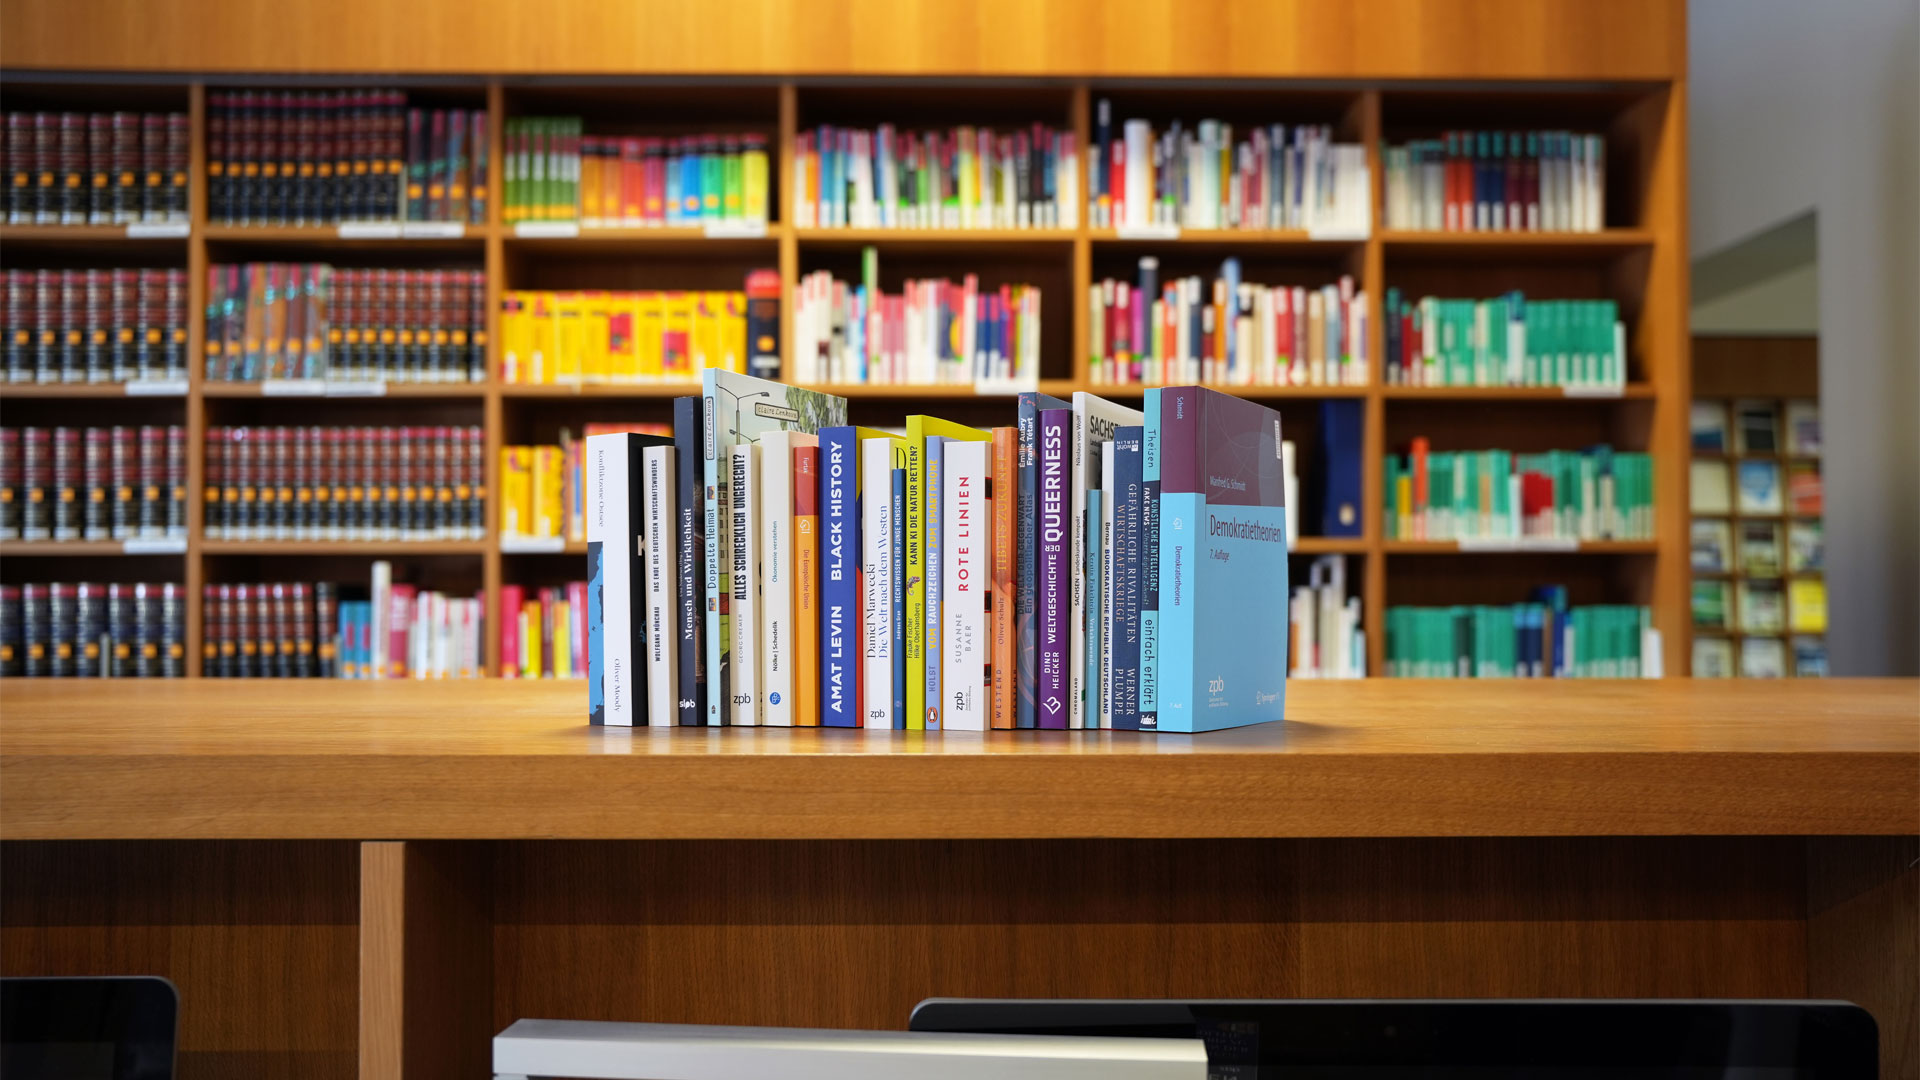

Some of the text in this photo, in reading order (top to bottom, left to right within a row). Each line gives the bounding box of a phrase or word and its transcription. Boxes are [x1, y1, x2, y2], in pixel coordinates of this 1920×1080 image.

[1090, 415, 1119, 440] SACHS
[1148, 429, 1156, 468] Theisen
[910, 446, 918, 482] RETTEN?
[1045, 425, 1063, 542] QUEERNESS
[1210, 475, 1226, 487] Manfred
[1231, 480, 1246, 491] Schmidt
[732, 454, 747, 600] ALLES SCHRECKLICH UNGERECHT?
[831, 441, 842, 581] BLACK HISTORY
[910, 530, 917, 539] KI
[959, 476, 969, 591] ROTE LINIEN
[996, 456, 1007, 573] TIBETS ZUKUNFT
[1210, 514, 1281, 543] Demokratietheorien
[706, 509, 717, 589] Doppelte Heimat
[893, 546, 901, 557] FÜR
[928, 459, 938, 650] VOM RAUCHZEICHEN ZUM SMARTPHONE
[1025, 523, 1033, 595] geopolitischer
[1116, 504, 1125, 623] WIRTSCHAFTSKRIEGE
[1127, 484, 1137, 643] GEFÄHRLICHE RIVALITÄTEN
[1150, 499, 1158, 592] KÜNSTLICHE INTELLIGENZ
[1209, 549, 1229, 562] 7. Auflage
[683, 508, 693, 640] Mensch und Wirklichkeit
[878, 505, 888, 658] Die Welt nach dem Westen
[866, 563, 876, 658] Daniel Marwecki
[1048, 554, 1056, 644] WELTGESCHICHTE
[831, 606, 842, 713] AMAT LEVIN
[1145, 619, 1155, 662] einfach
[734, 693, 751, 706] zpb
[928, 666, 936, 692] HOLST
[954, 691, 964, 711] zpb
[1115, 668, 1124, 715] PLUMPE
[1126, 668, 1135, 715] WERNER
[1144, 667, 1154, 705] erklärt
[1208, 675, 1224, 696] zpb
[870, 709, 885, 719] zpb
